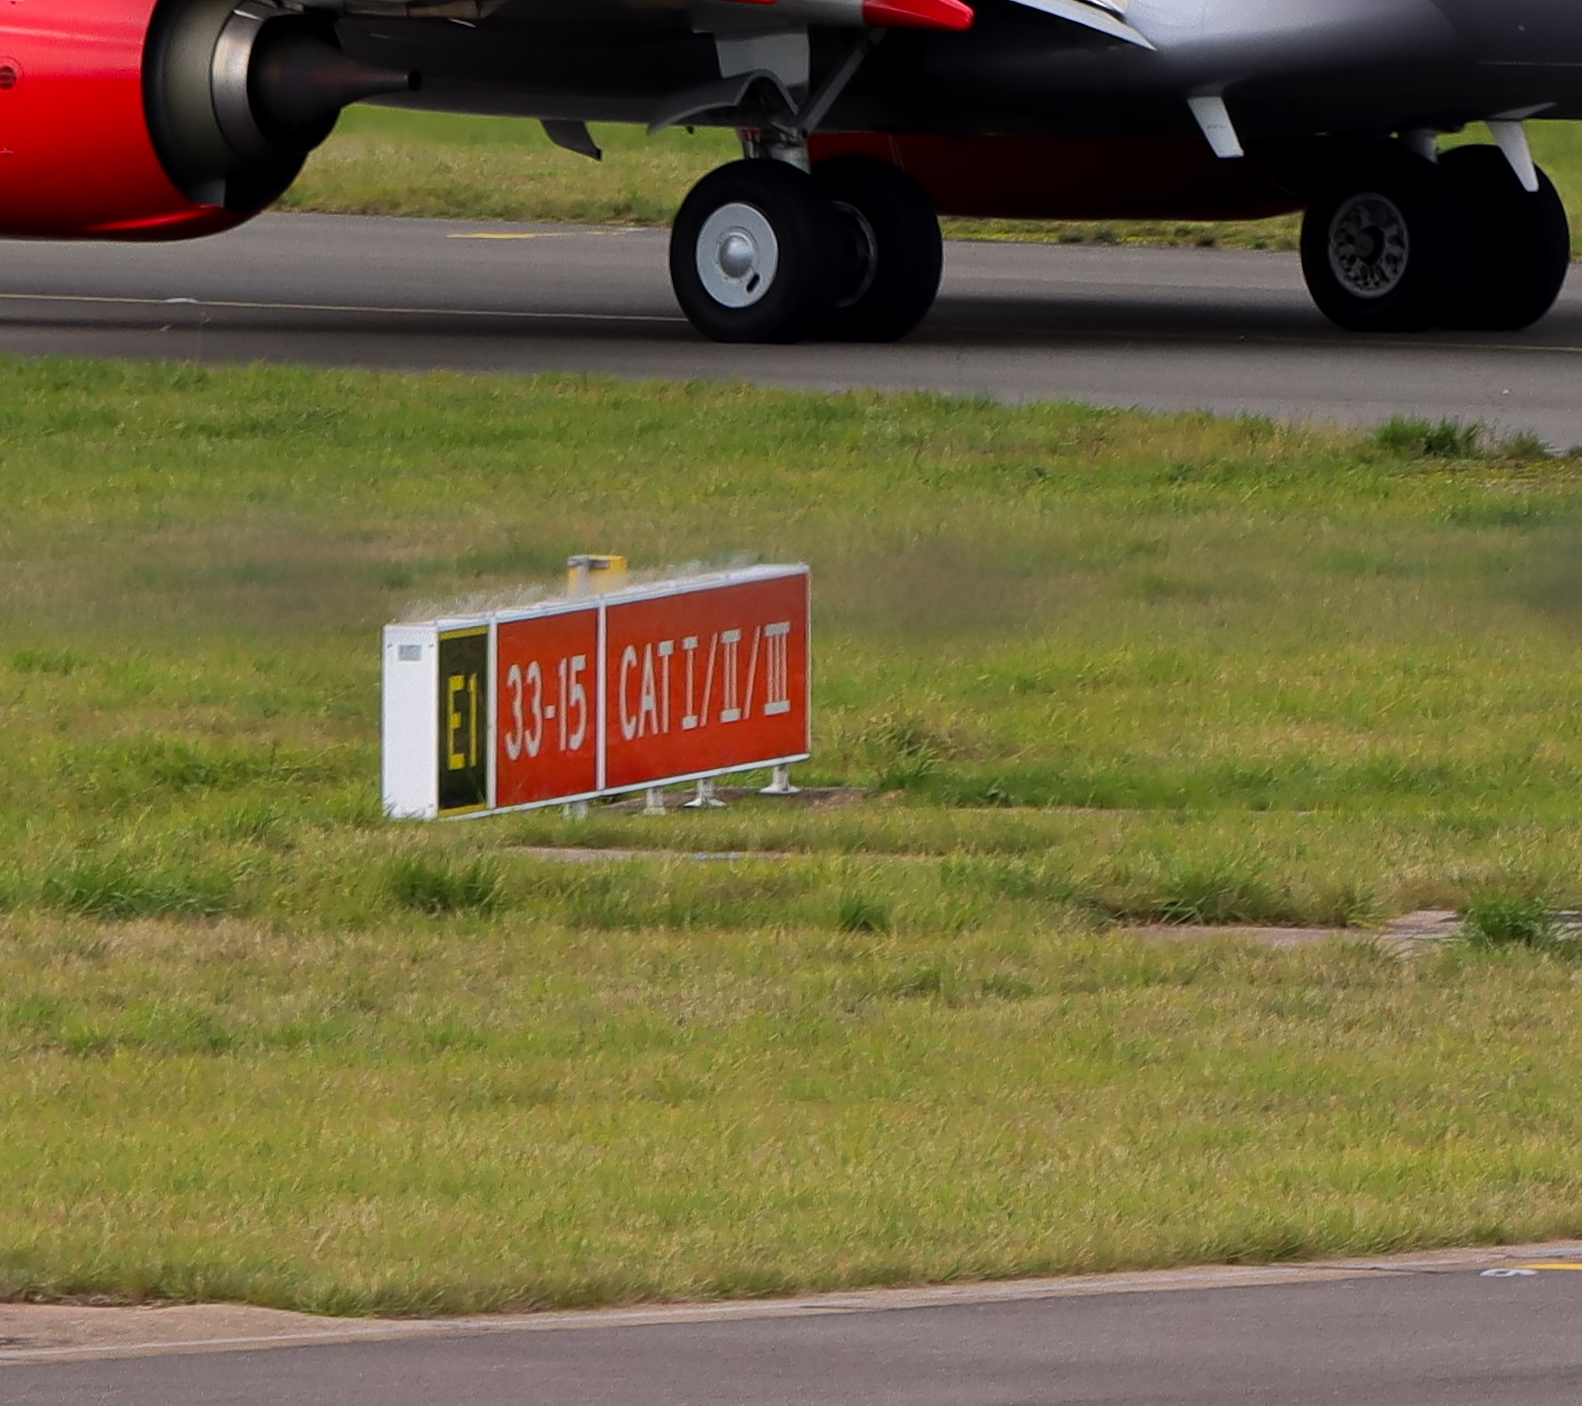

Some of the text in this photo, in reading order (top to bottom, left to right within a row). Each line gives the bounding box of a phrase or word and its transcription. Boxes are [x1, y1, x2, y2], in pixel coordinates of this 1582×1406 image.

[447, 673, 478, 770] E1
[504, 654, 587, 761] 33-15
[619, 638, 674, 741] CAT
